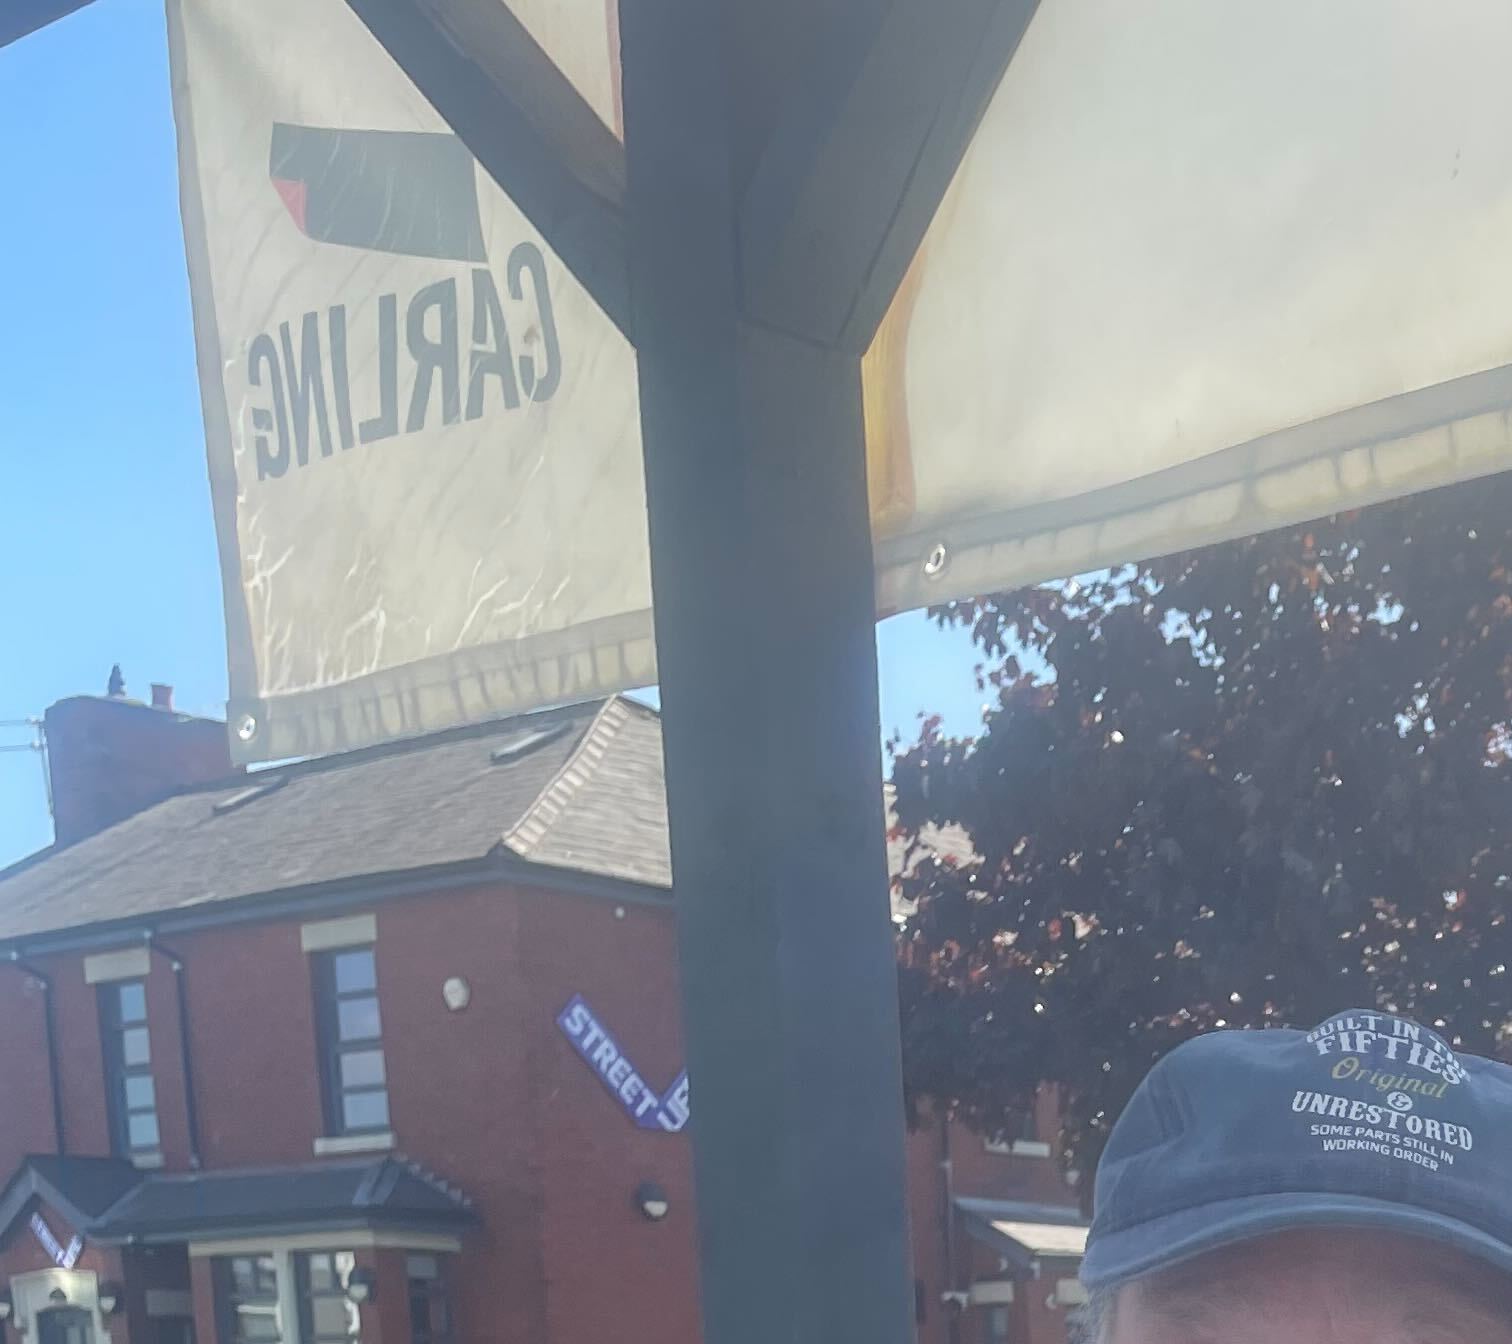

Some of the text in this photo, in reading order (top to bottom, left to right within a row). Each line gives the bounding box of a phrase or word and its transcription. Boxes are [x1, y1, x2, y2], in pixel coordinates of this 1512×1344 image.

[1306, 1015, 1383, 1043] BUILT
[1394, 1019, 1420, 1041] IN
[564, 1003, 658, 1118] STREET
[1315, 1030, 1461, 1085] FIFTIES
[1331, 1056, 1449, 1098] Original
[1292, 1091, 1473, 1151] UNRESTORED
[1386, 1091, 1413, 1112] &
[1310, 1124, 1454, 1165] SOME PARTS STILL IN
[1322, 1139, 1439, 1171] WORKING ORDER
